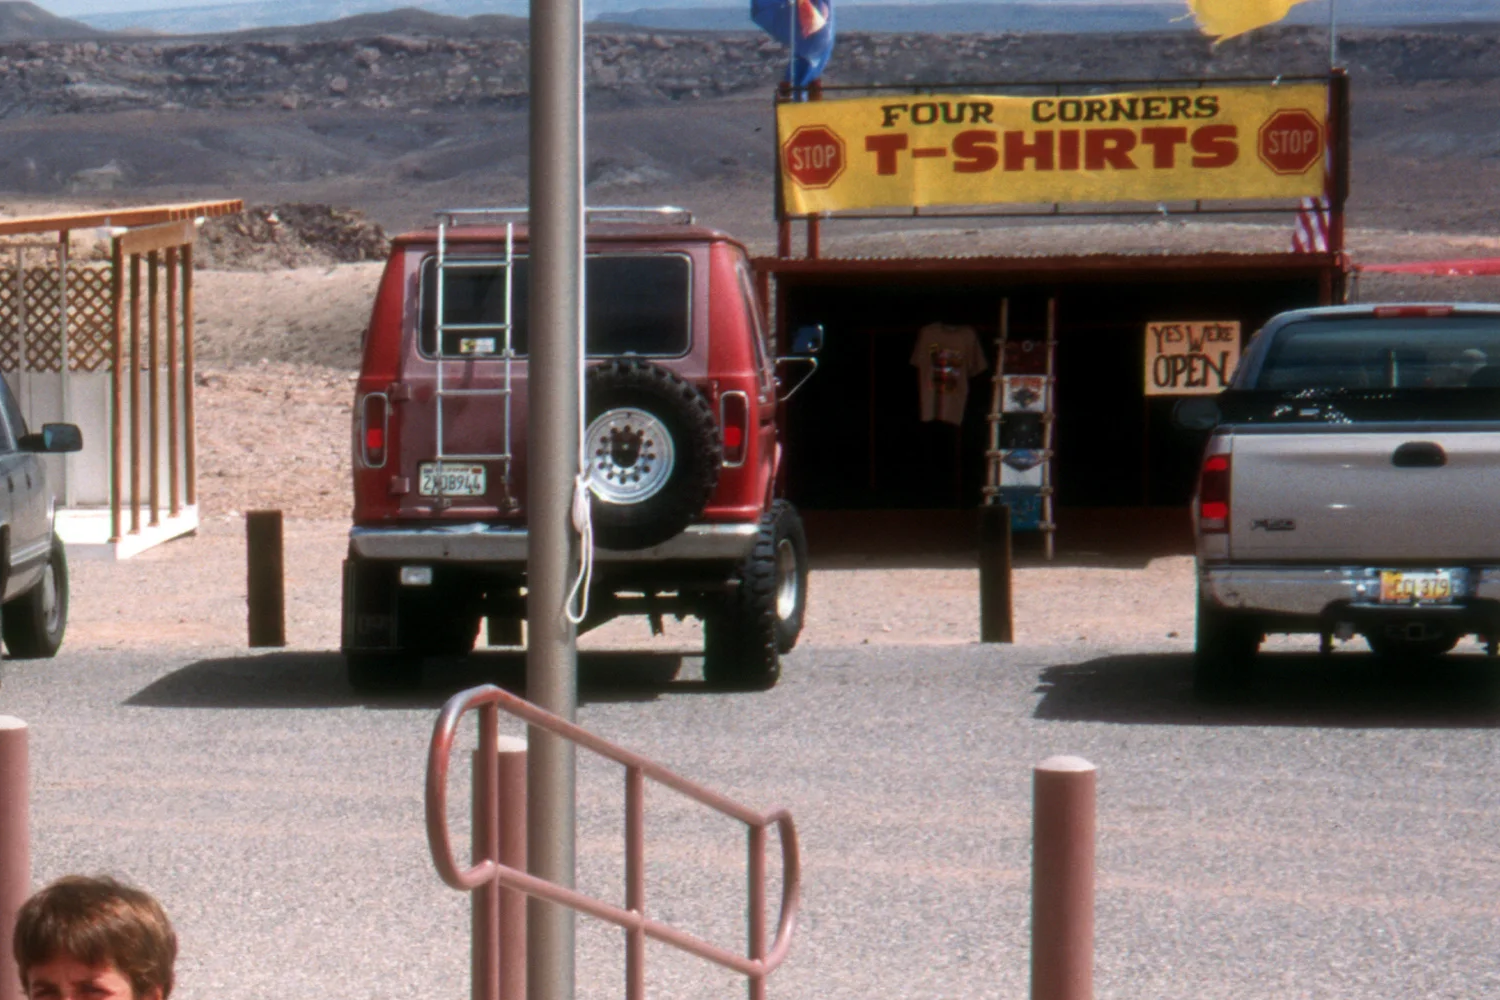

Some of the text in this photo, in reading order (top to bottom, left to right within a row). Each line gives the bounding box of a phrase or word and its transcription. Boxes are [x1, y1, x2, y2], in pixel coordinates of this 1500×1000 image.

[881, 96, 1220, 127] FOUR CORNERS
[866, 125, 1240, 175] T-SHIRTS
[1268, 128, 1314, 155] STOP
[791, 145, 836, 171] STOP
[1151, 324, 1184, 352] YES
[1154, 351, 1231, 387] OPEN
